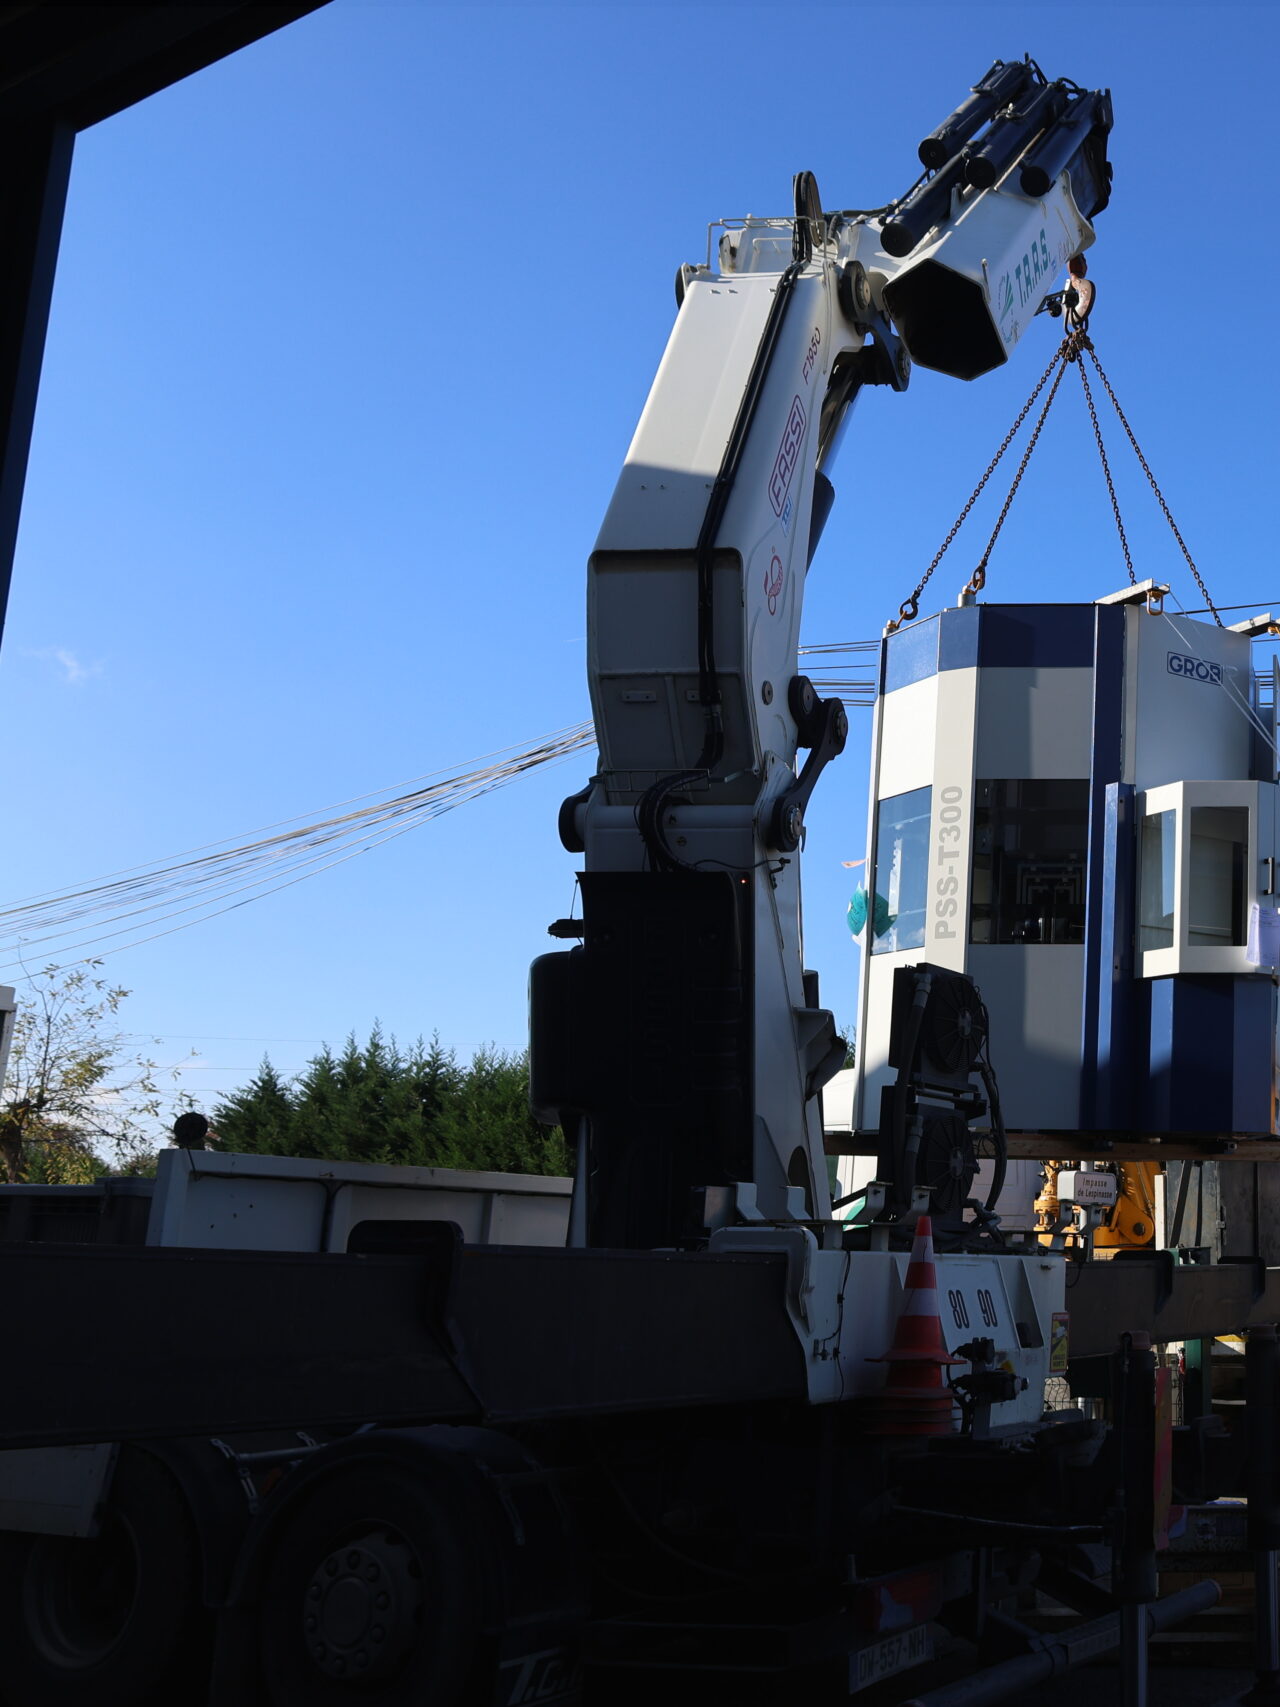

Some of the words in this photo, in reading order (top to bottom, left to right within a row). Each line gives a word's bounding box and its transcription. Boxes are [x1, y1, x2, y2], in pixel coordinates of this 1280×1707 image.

[771, 404, 804, 508] FASSI
[1169, 655, 1221, 683] GROB
[935, 786, 963, 939] PSS-T300
[1077, 1188, 1084, 1197] de
[948, 1289, 969, 1329] 80
[977, 1289, 998, 1327] 90
